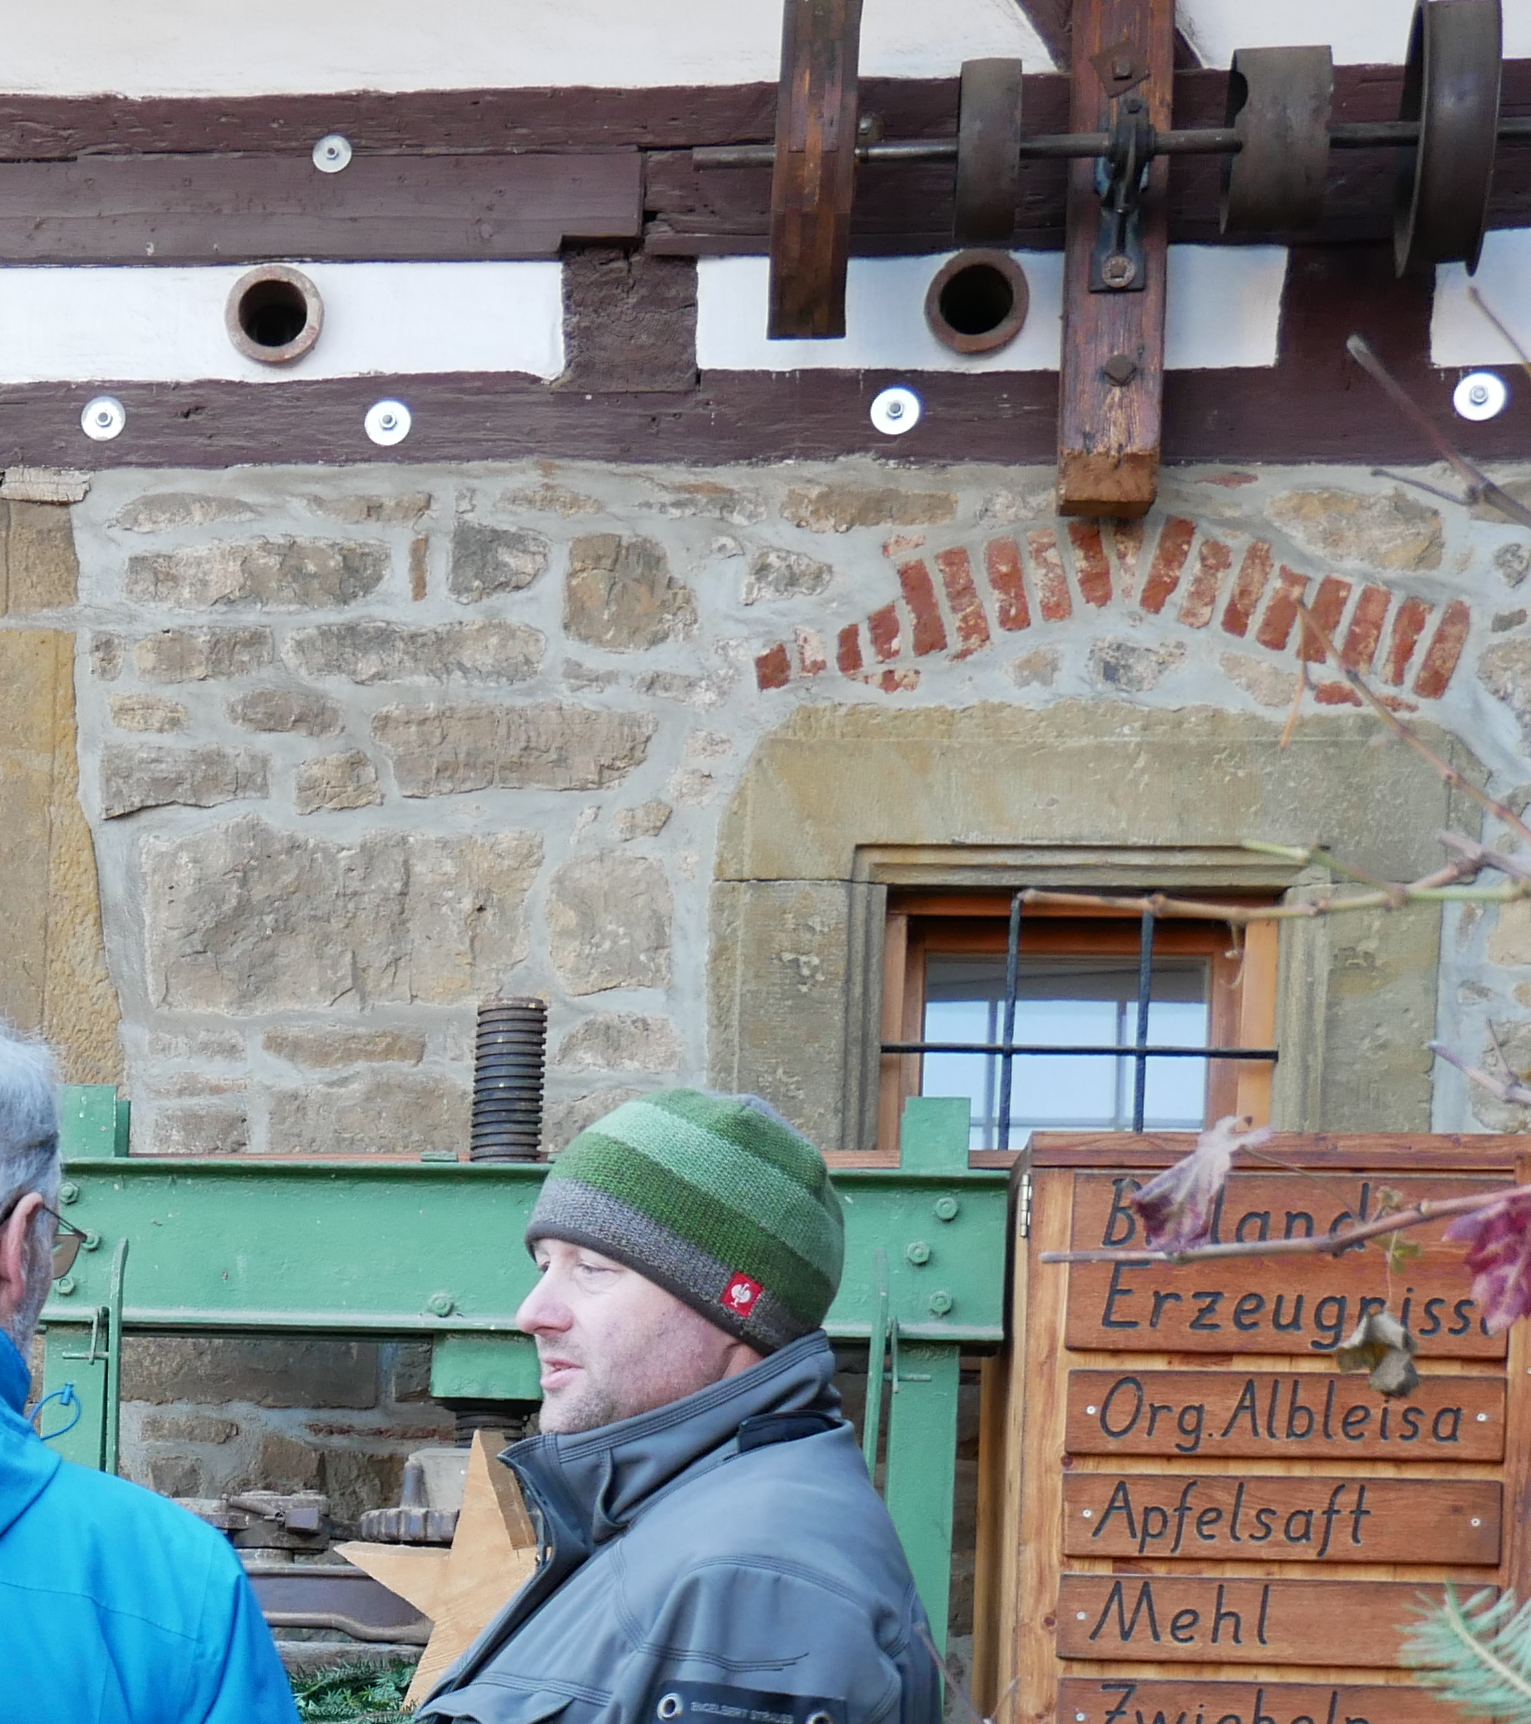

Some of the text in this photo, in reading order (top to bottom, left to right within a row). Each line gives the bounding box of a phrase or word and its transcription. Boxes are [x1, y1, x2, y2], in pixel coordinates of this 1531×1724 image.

[1102, 1178, 1370, 1251] Bland
[1091, 1480, 1372, 1558] Apfelsaft
[1089, 1580, 1271, 1646] Mehl
